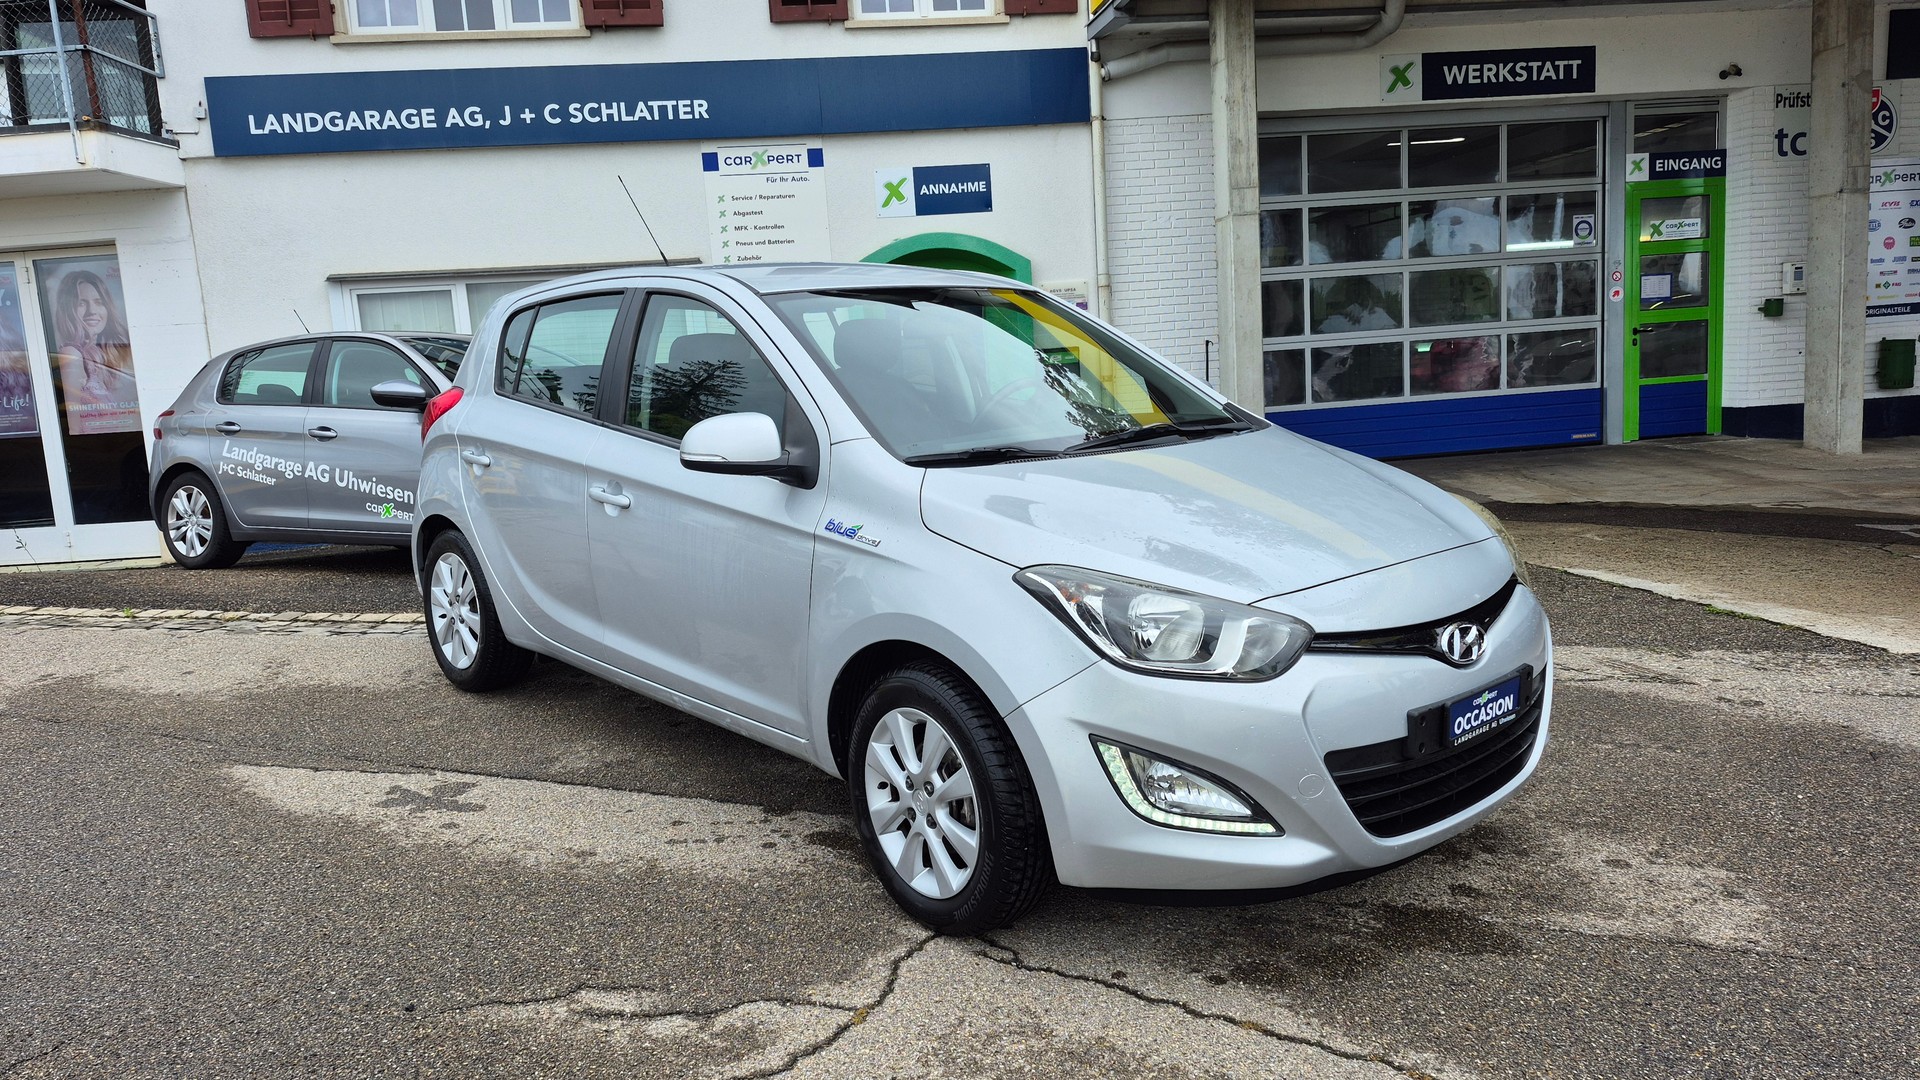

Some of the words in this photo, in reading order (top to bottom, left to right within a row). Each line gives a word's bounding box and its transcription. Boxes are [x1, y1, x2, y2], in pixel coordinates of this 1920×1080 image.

[1443, 59, 1582, 85] WERKSTATT
[1775, 92, 1812, 108] Prüfst
[248, 108, 438, 136] LANDGARAGE
[445, 106, 492, 130] AG,
[498, 105, 513, 127] J
[520, 107, 536, 124] +
[543, 103, 560, 126] C
[569, 99, 710, 124] SCHLATTER
[1774, 128, 1807, 158] tc
[1655, 156, 1722, 172] EINGANG
[766, 176, 778, 184] Für
[790, 175, 810, 183] Auto.
[919, 181, 987, 195] ANNAHME
[731, 194, 753, 202] Service
[758, 193, 796, 202] Reparaturen
[733, 209, 764, 218] Abgastest
[734, 224, 749, 232] MFK
[753, 223, 785, 231] Kontrollen
[735, 239, 753, 247] Pneus
[767, 237, 795, 246] Batterien
[737, 253, 762, 262] Zubehör
[3, 393, 29, 411] Life!
[69, 402, 118, 412] SHINEFINITY
[219, 461, 235, 475] J+C
[237, 467, 277, 486] Schlatter
[222, 440, 302, 480] Landgarage
[304, 461, 330, 483] AG
[335, 467, 414, 505] Uhwiesen
[824, 518, 858, 540] blue
[1454, 693, 1514, 735] OCCASION
[1454, 723, 1490, 746] LANDGARAGE
